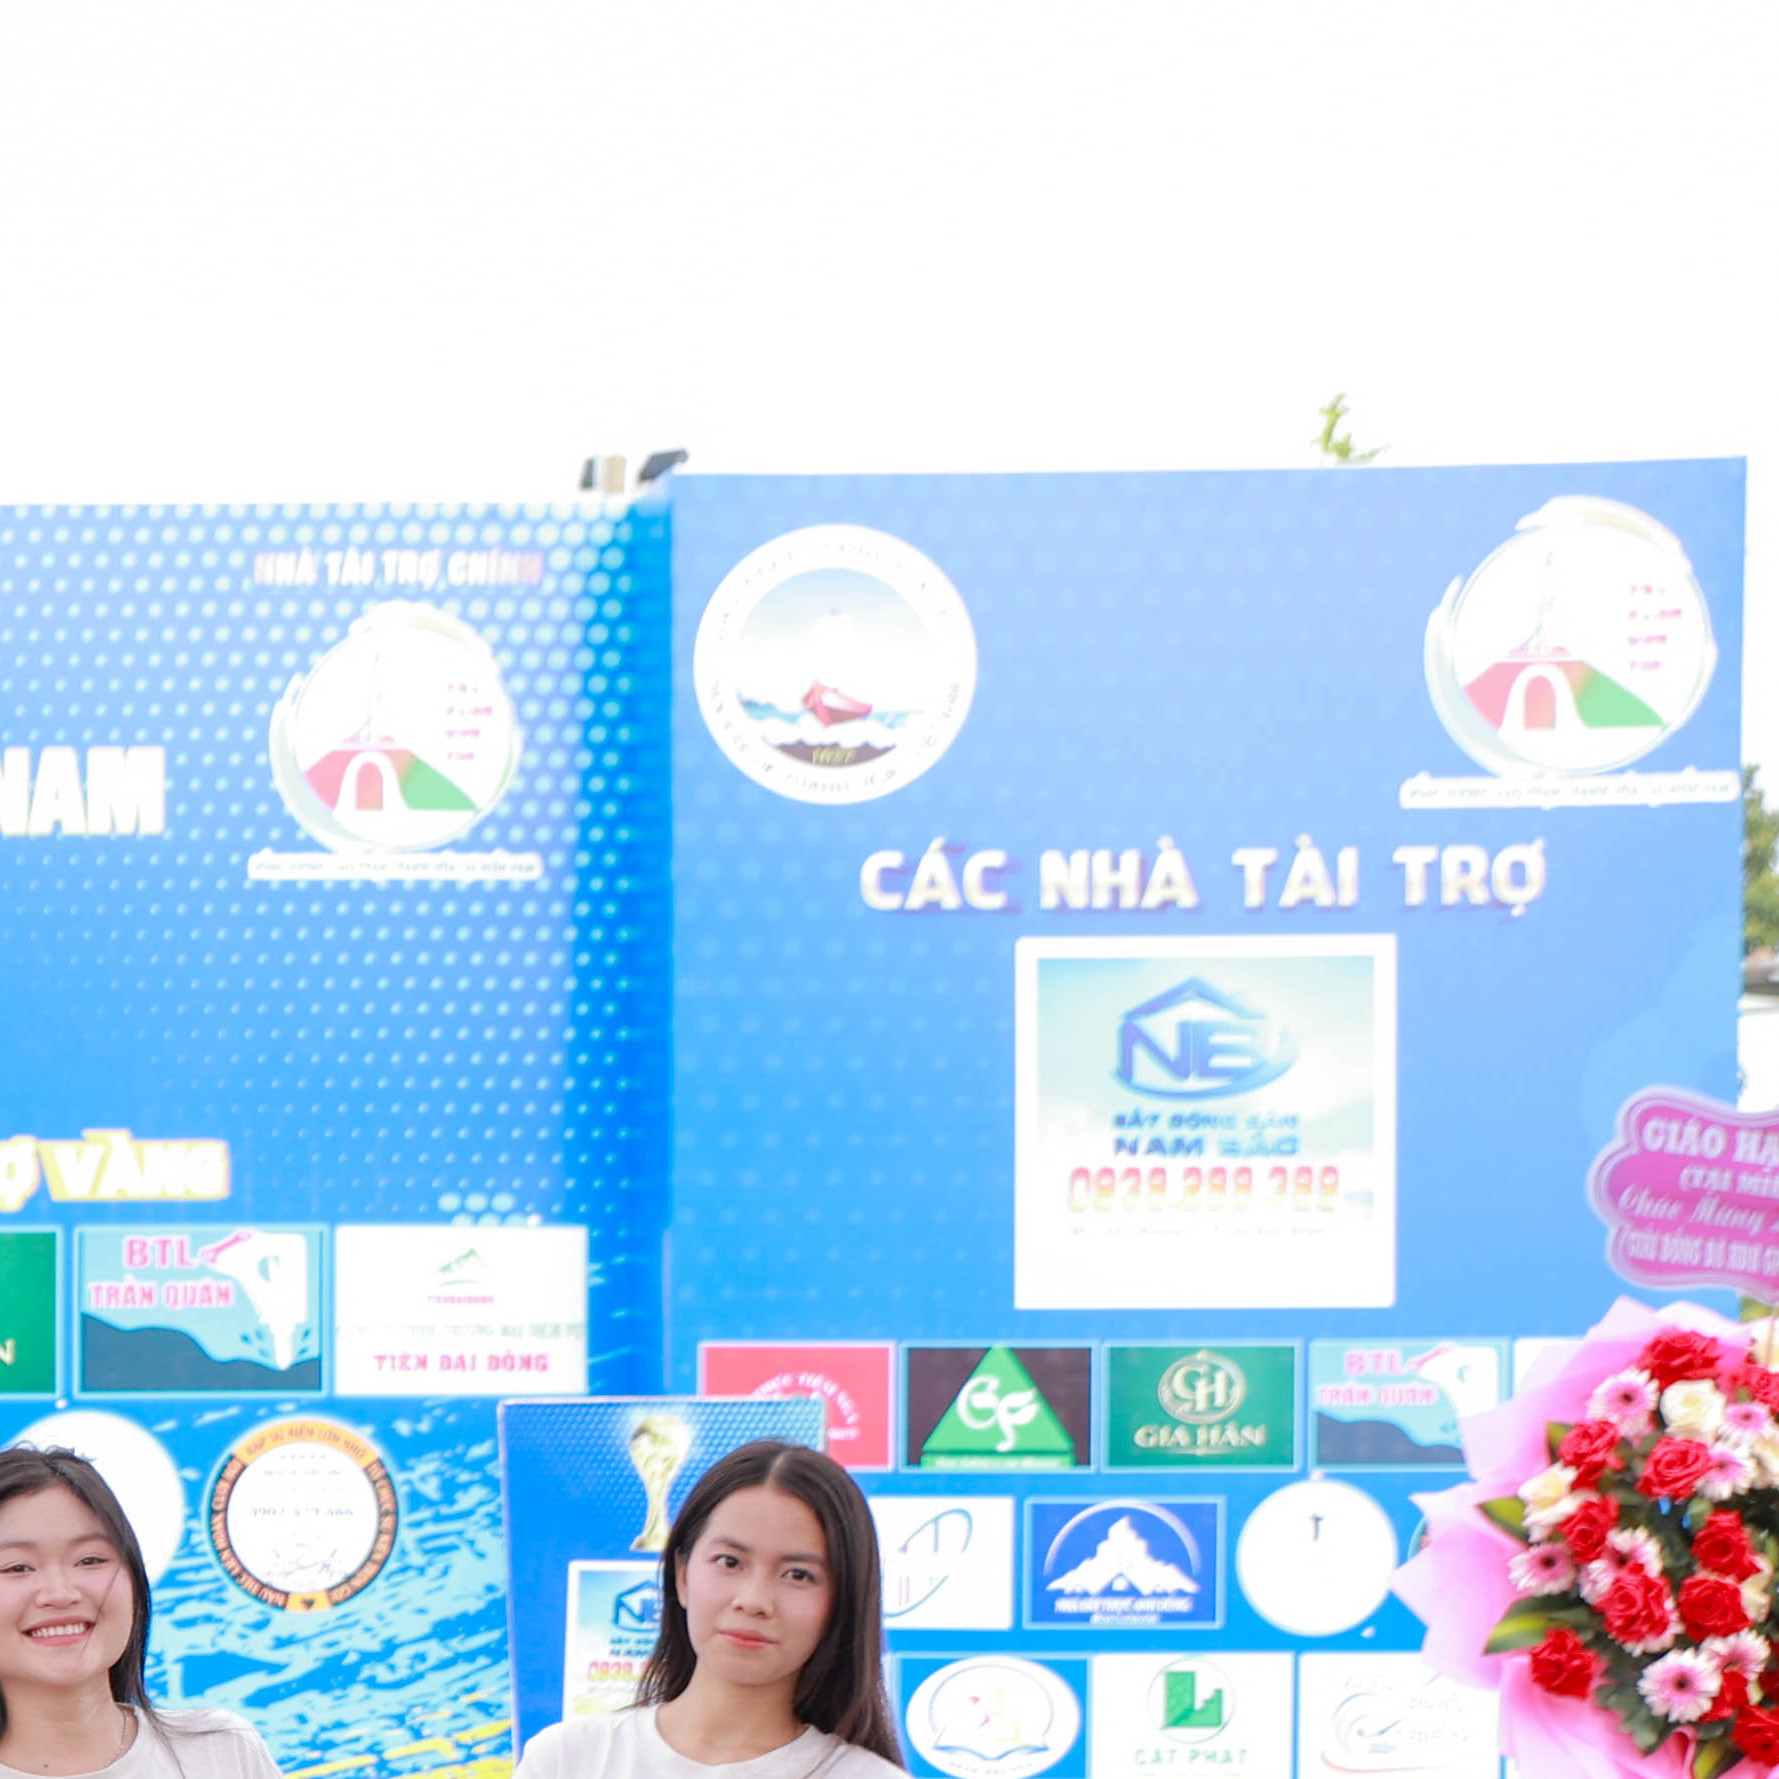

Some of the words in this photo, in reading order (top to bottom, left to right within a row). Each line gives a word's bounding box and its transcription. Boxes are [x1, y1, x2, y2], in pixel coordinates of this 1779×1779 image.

[254, 547, 317, 586] NHÀ
[325, 546, 374, 585] TÀI
[382, 549, 440, 591] TRỢ
[448, 547, 542, 585] CHÍNH
[860, 838, 1006, 911] CÁC
[1040, 837, 1198, 910] NHÀ
[1233, 836, 1358, 908] TÀI
[1393, 838, 1546, 917] TRỢ
[1114, 1136, 1205, 1157] NAM
[1643, 1115, 1725, 1159] GIÁO
[1731, 1128, 1779, 1172] HẠ
[44, 1129, 230, 1202] VÀNG
[124, 1236, 197, 1269] BTL
[1345, 1350, 1409, 1377] BTL
[1134, 1425, 1197, 1449] GIA
